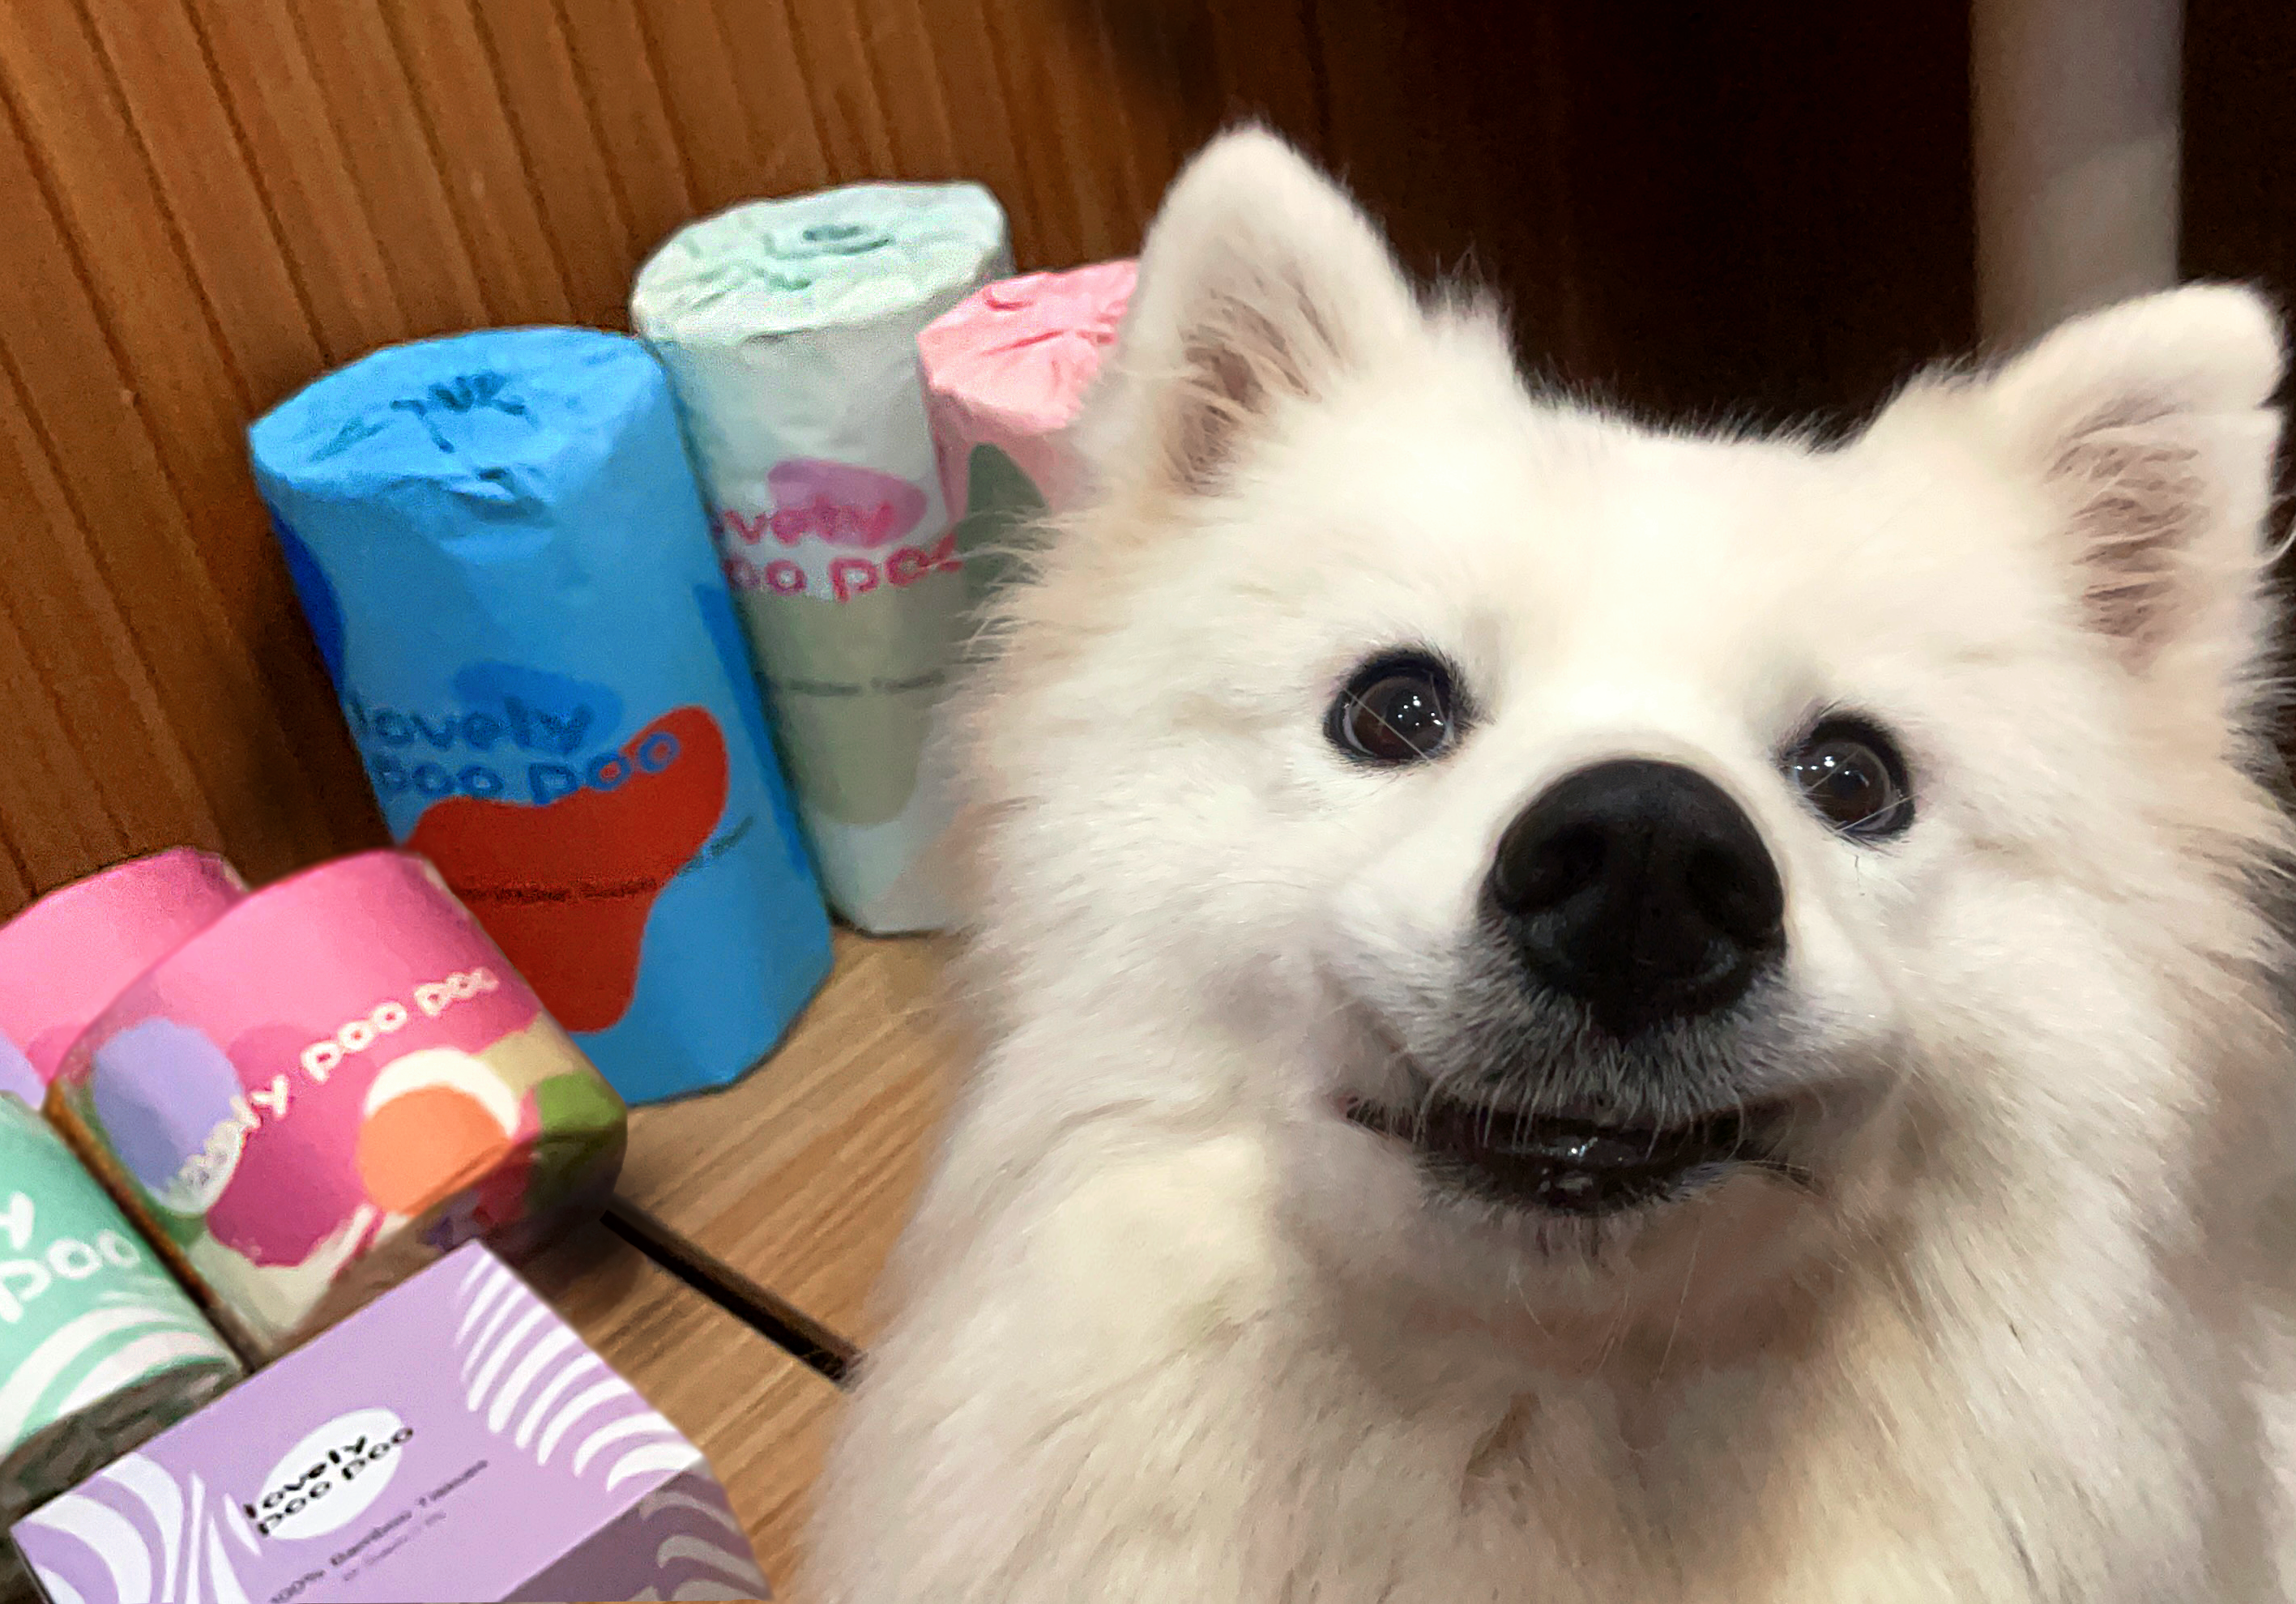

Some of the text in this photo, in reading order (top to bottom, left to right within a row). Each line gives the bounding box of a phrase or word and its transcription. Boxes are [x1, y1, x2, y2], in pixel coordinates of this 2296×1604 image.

[351, 695, 595, 755] lovely
[371, 732, 681, 806] poo poo
[301, 1001, 408, 1083] poo
[0, 1228, 141, 1325] poo
[244, 1435, 367, 1519] lovely
[258, 1427, 414, 1538] poo poo
